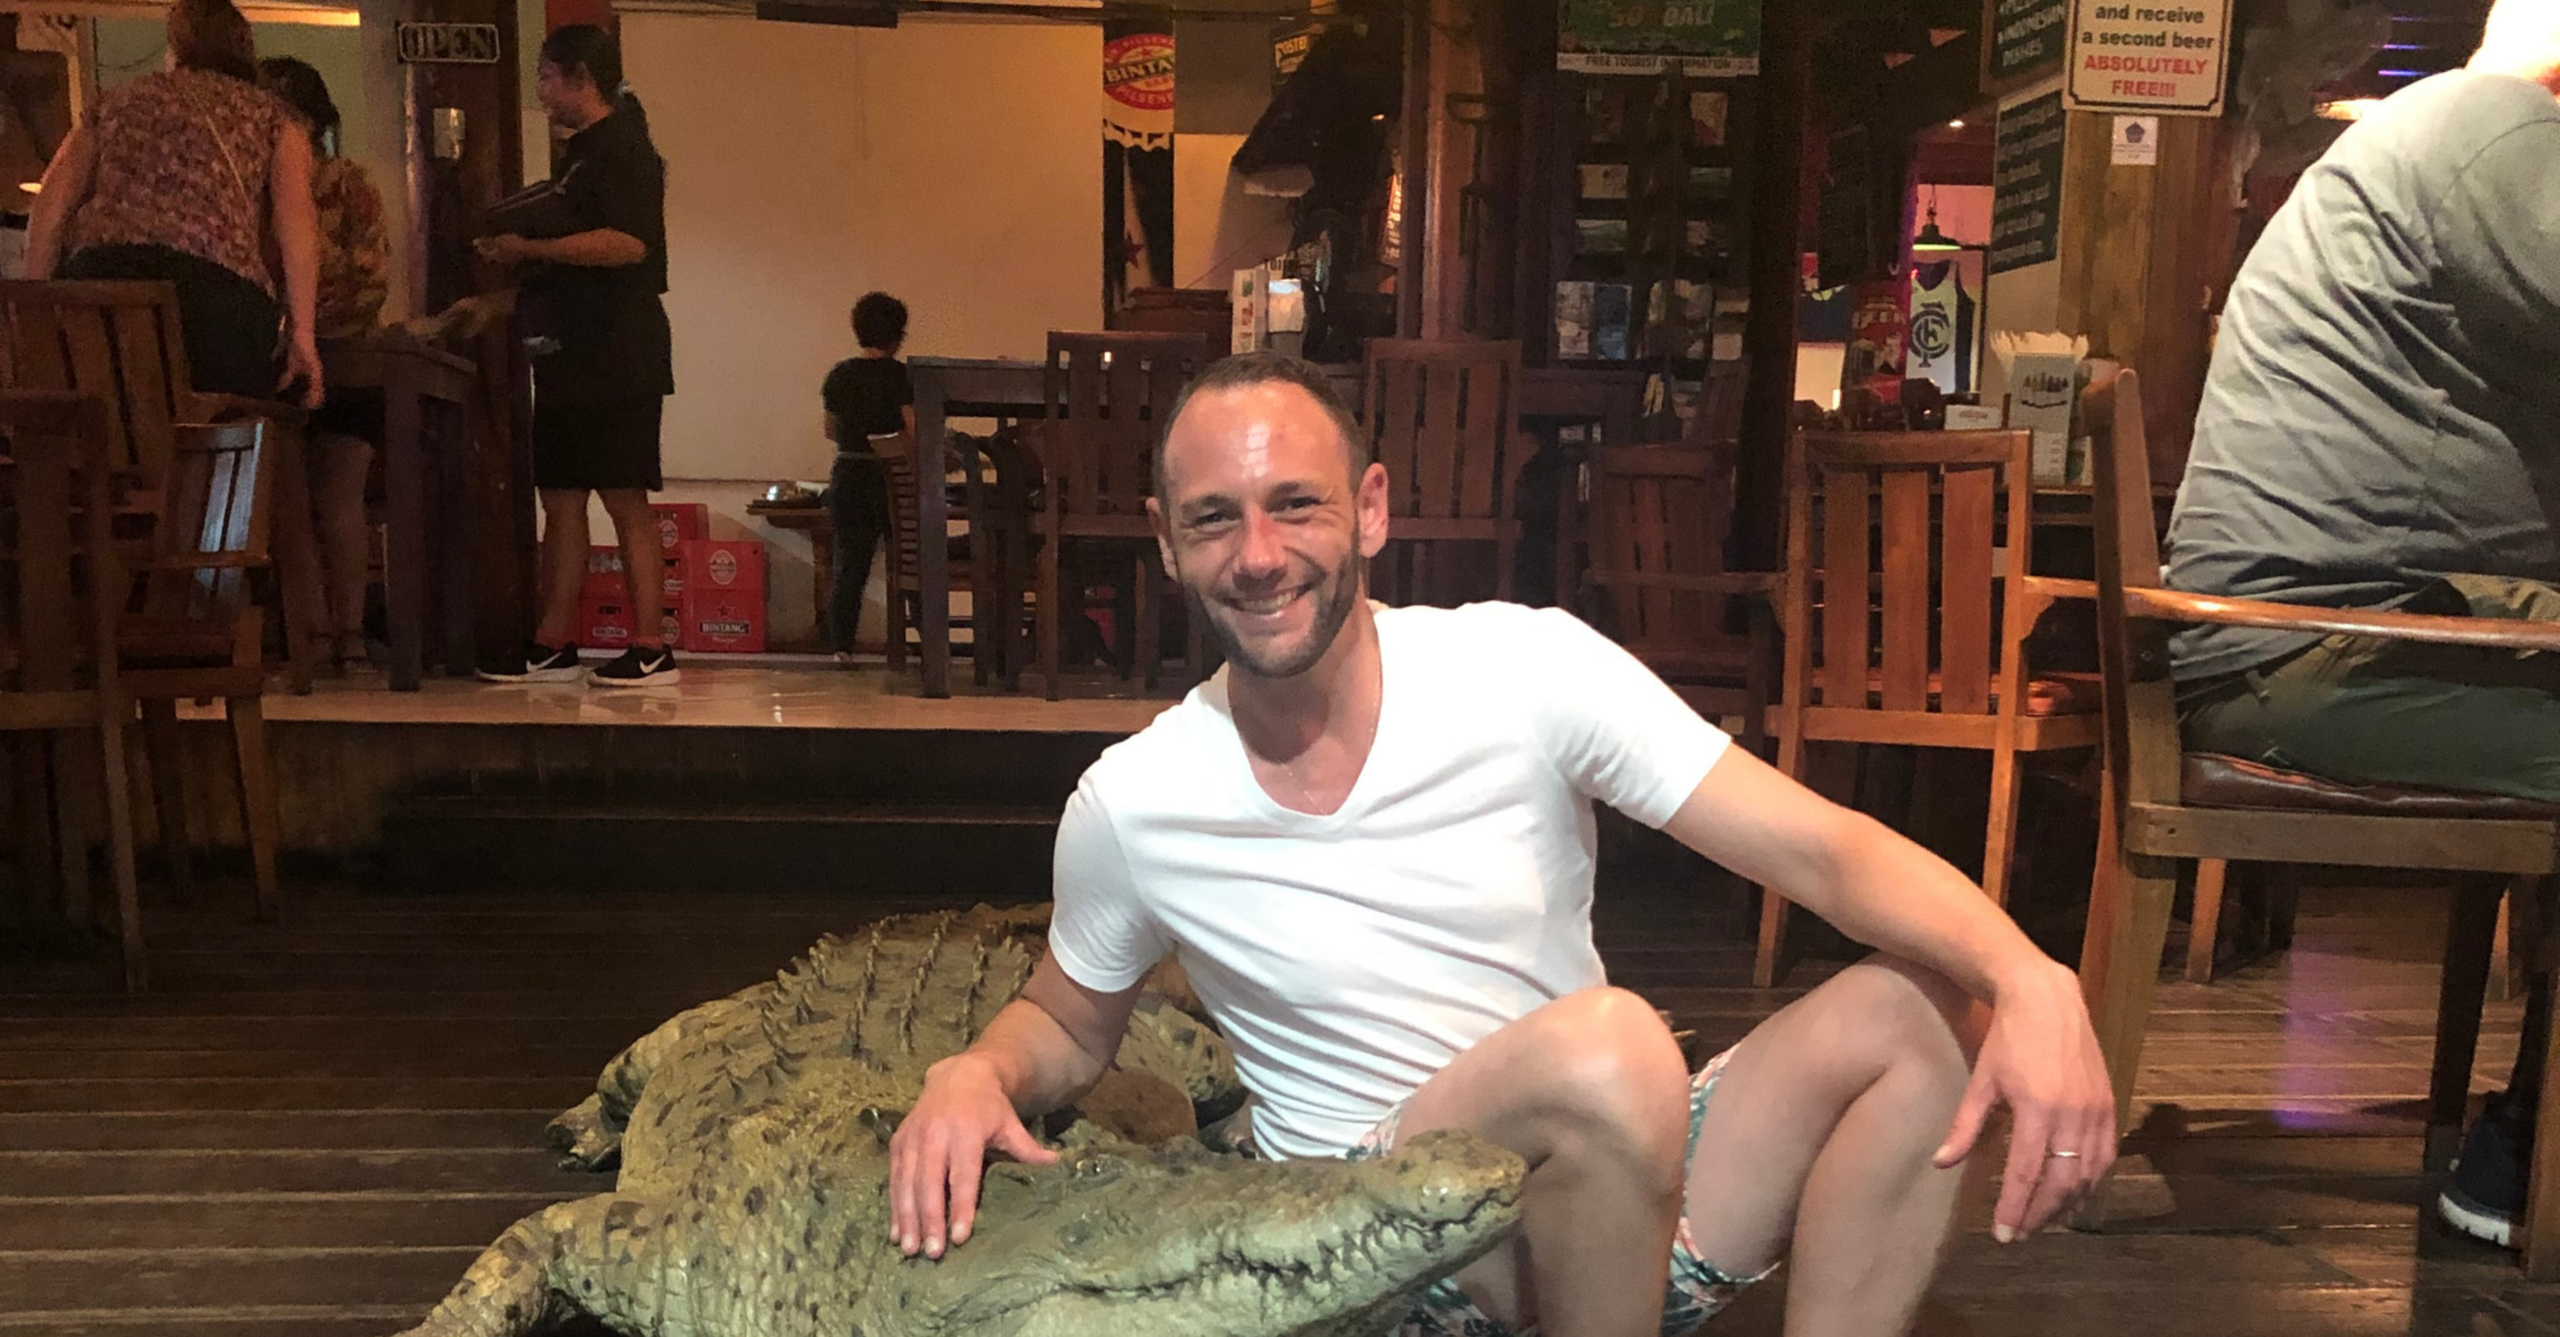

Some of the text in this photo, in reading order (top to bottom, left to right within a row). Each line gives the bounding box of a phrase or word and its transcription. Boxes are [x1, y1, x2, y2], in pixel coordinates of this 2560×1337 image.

[2095, 4, 2205, 24] and receive
[404, 26, 491, 57] OPEN
[2082, 30, 2216, 49] a second beer
[1585, 56, 1612, 67] FREE
[2084, 55, 2208, 75] ABSOLUTELY
[2110, 79, 2177, 98] FREE!!!
[702, 623, 746, 633] BINTANG
